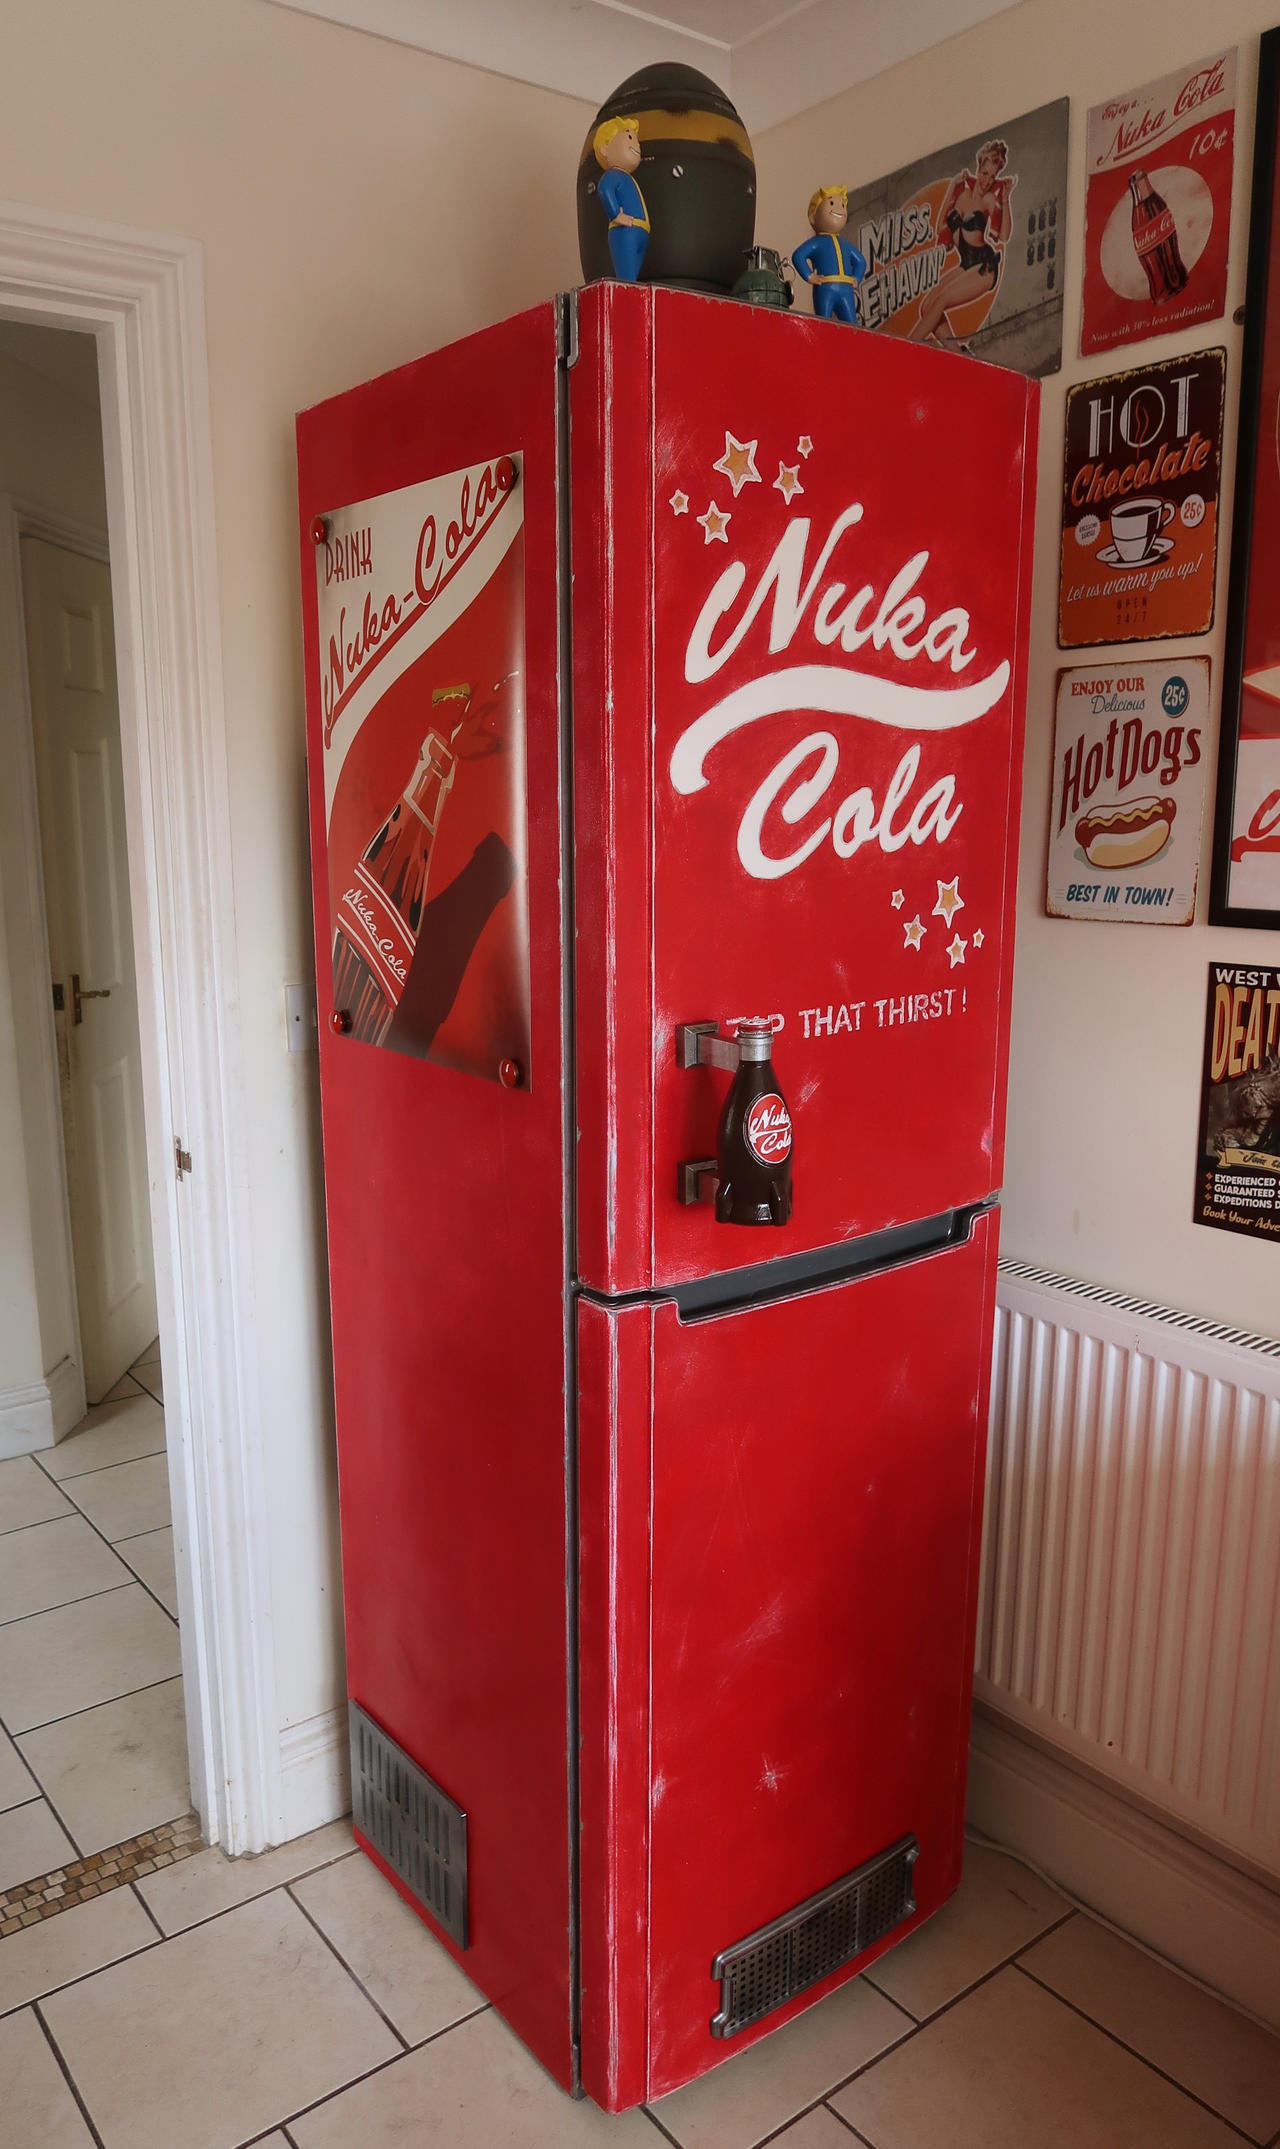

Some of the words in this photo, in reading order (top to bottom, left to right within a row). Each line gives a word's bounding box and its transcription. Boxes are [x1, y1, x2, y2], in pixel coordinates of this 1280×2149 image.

[1097, 109, 1166, 167] Nuka
[1174, 56, 1226, 117] Cola
[1189, 128, 1228, 160] 10¢
[854, 246, 946, 329] EHAVIN'
[1112, 324, 1131, 337] with
[1152, 314, 1168, 326] less
[1170, 299, 1215, 321] radiation!
[1088, 373, 1199, 458] HOT
[1071, 431, 1212, 507] Chocolate
[1183, 501, 1202, 521] 25¢
[325, 527, 373, 587] DRINK
[1067, 584, 1085, 603] Let
[1086, 584, 1100, 598] us
[1102, 571, 1149, 597] warm
[1149, 566, 1175, 593] you
[1177, 553, 1204, 581] up!
[685, 502, 978, 684] Nuka
[1116, 597, 1147, 610] OPEN
[1071, 678, 1114, 697] ENJOY
[1116, 677, 1145, 693] OUR
[1164, 684, 1187, 708] 25¢
[1090, 694, 1146, 715] Delicious
[737, 731, 963, 880] Cola
[1066, 884, 1101, 902] BEST
[1104, 886, 1120, 904] IN
[1125, 886, 1175, 907] TOWN!
[1215, 968, 1272, 987] WEST
[798, 1001, 866, 1039] THAT
[1214, 1173, 1276, 1187] EXPERIENCED
[1214, 1184, 1275, 1198] GUARANTEED
[1203, 1205, 1227, 1220] Book
[1228, 1211, 1254, 1226] Your
[1213, 1194, 1273, 1209] EXPEDITIONS
